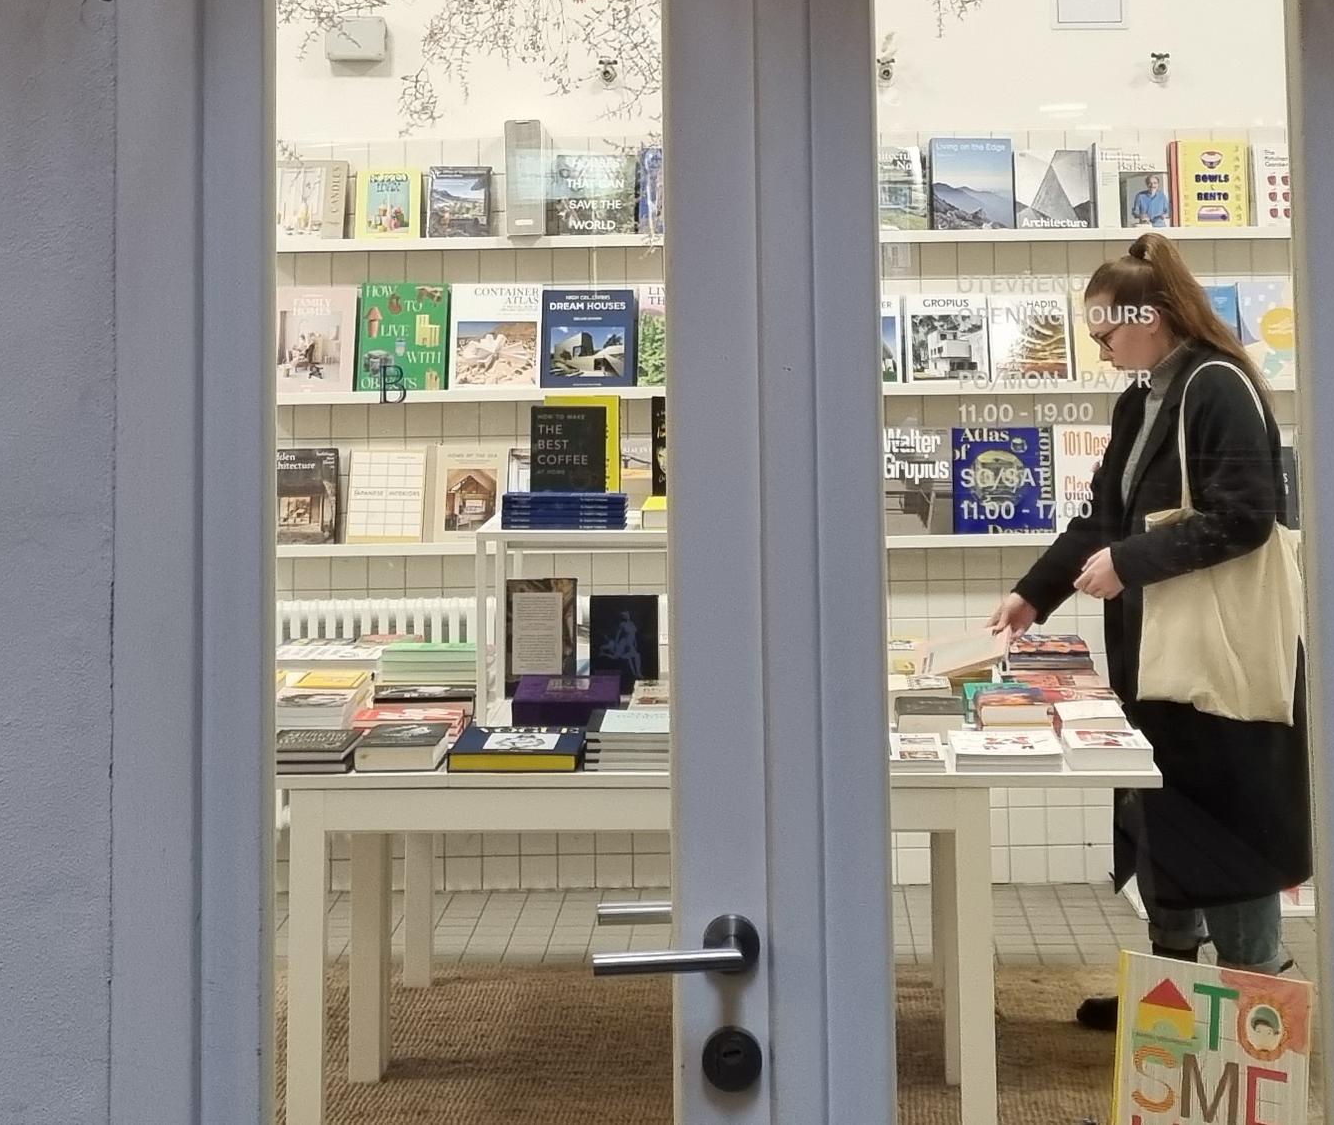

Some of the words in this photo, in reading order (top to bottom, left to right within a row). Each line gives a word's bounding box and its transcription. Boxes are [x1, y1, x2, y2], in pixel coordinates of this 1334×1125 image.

[936, 143, 958, 152] Living
[971, 143, 984, 151] the
[986, 143, 1006, 152] Edge
[1100, 151, 1141, 161] Italian
[896, 160, 913, 171] No
[1117, 161, 1156, 171] Bakes
[567, 179, 594, 189] THAT
[598, 179, 624, 189] CAN
[1195, 174, 1229, 183] BOWLS
[1197, 192, 1229, 201] BENTO
[569, 200, 597, 209] SAVE
[600, 199, 622, 209] THE
[572, 220, 616, 230] WORLD
[1022, 218, 1088, 229] Architecture
[366, 285, 397, 297] HOW
[474, 287, 539, 297] CONTAINER
[404, 300, 422, 312] TO
[505, 296, 539, 305] ATLAS
[923, 299, 969, 308] GROPIUS
[1027, 300, 1058, 308] HADID
[549, 302, 584, 311] DREAM
[587, 302, 626, 310] HOUSES
[957, 306, 1064, 325] OPENING
[1073, 305, 1154, 325] HOURS
[380, 325, 410, 337] LIVE
[406, 351, 441, 364] WITH
[379, 365, 407, 404] B
[958, 370, 1058, 391] PO/MON
[958, 403, 1014, 423] 11.00
[1034, 402, 1094, 422] 19.00
[537, 424, 563, 435] THE
[883, 428, 941, 453] Walter
[960, 428, 1009, 443] Atlas
[537, 439, 569, 450] BEST
[1063, 431, 1082, 456] 101
[537, 454, 588, 465] COFFEE
[884, 454, 950, 484] Gropius
[960, 467, 1049, 493] SO/SAT
[353, 489, 384, 497] JAPANESE
[960, 500, 1015, 520] 11.00
[1036, 500, 1093, 520] 17.00
